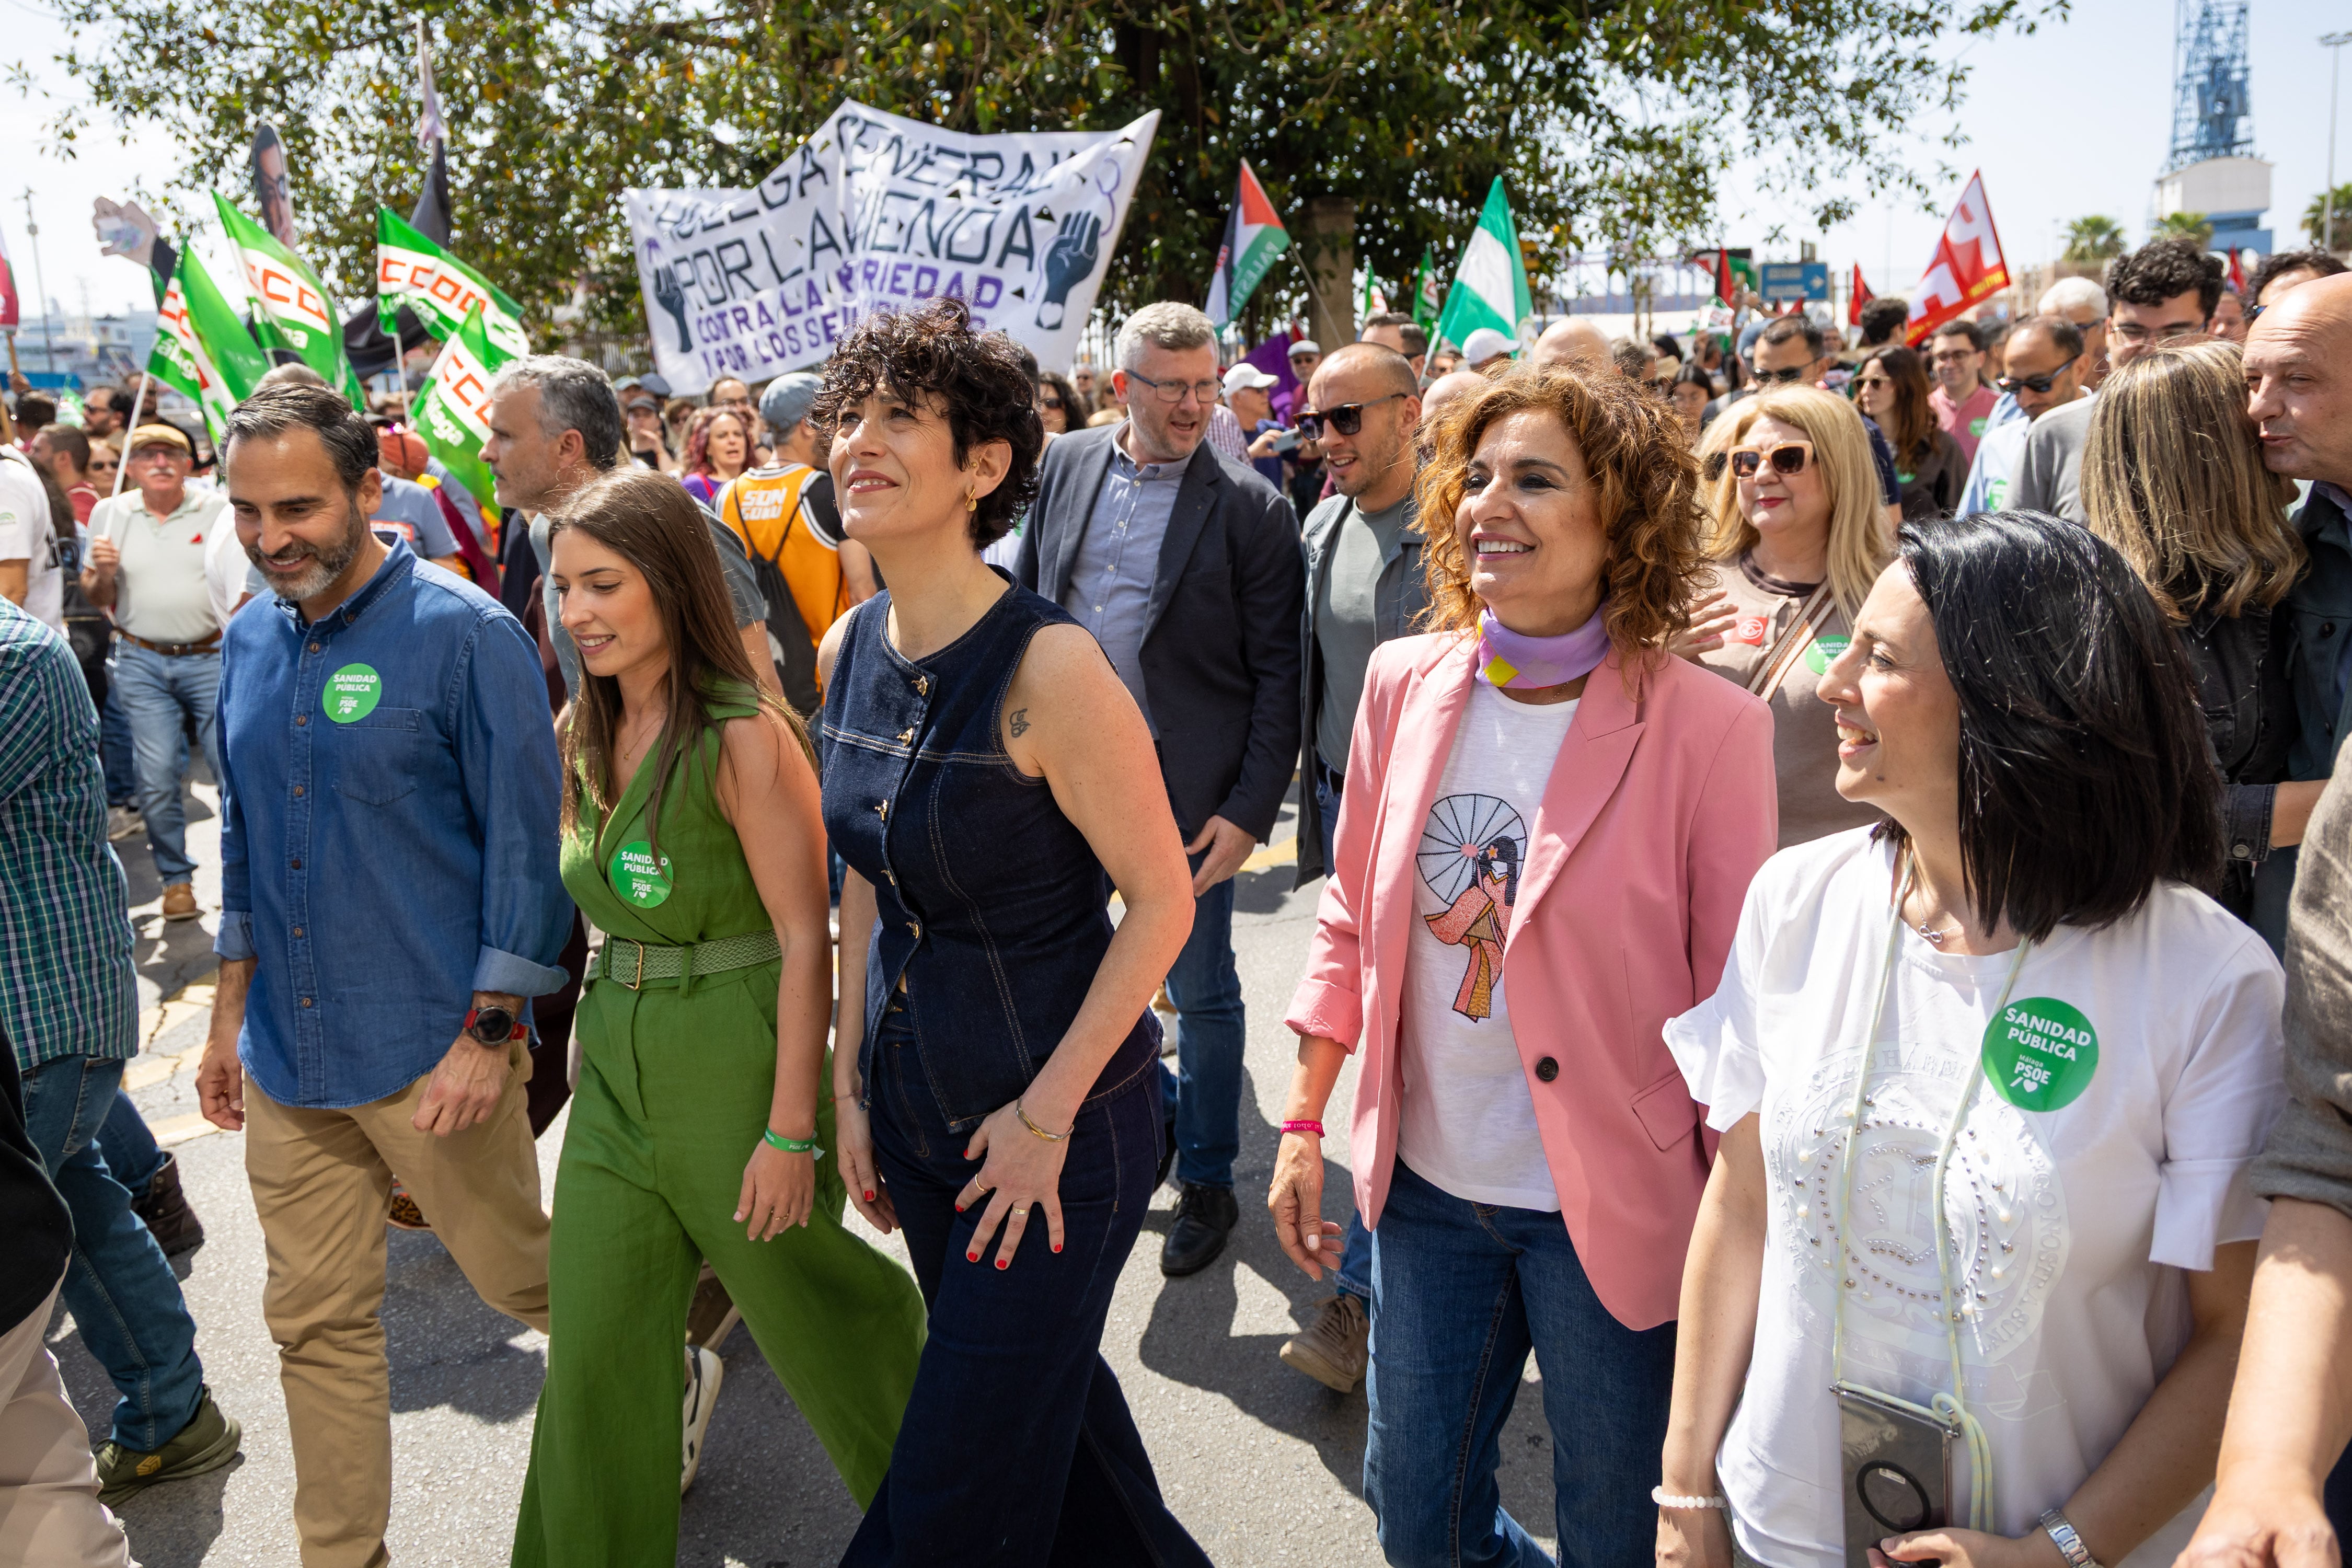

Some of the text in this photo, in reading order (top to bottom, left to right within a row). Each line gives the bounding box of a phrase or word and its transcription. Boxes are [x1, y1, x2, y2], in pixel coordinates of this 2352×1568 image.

[674, 238, 762, 307] POR
[759, 207, 842, 284] LA
[779, 278, 823, 317] LA
[755, 325, 802, 363] LOS
[741, 487, 788, 506] SON
[333, 674, 377, 683] SANIDAD
[336, 683, 371, 692] PÚBLICA
[620, 851, 668, 866] SANIDD
[632, 882, 652, 892] PSOE
[2004, 1007, 2091, 1046] SANIDAD
[2007, 1027, 2076, 1062] PÚBLICA
[2019, 1054, 2044, 1068] Málaga
[2014, 1062, 2051, 1085] PSOE
